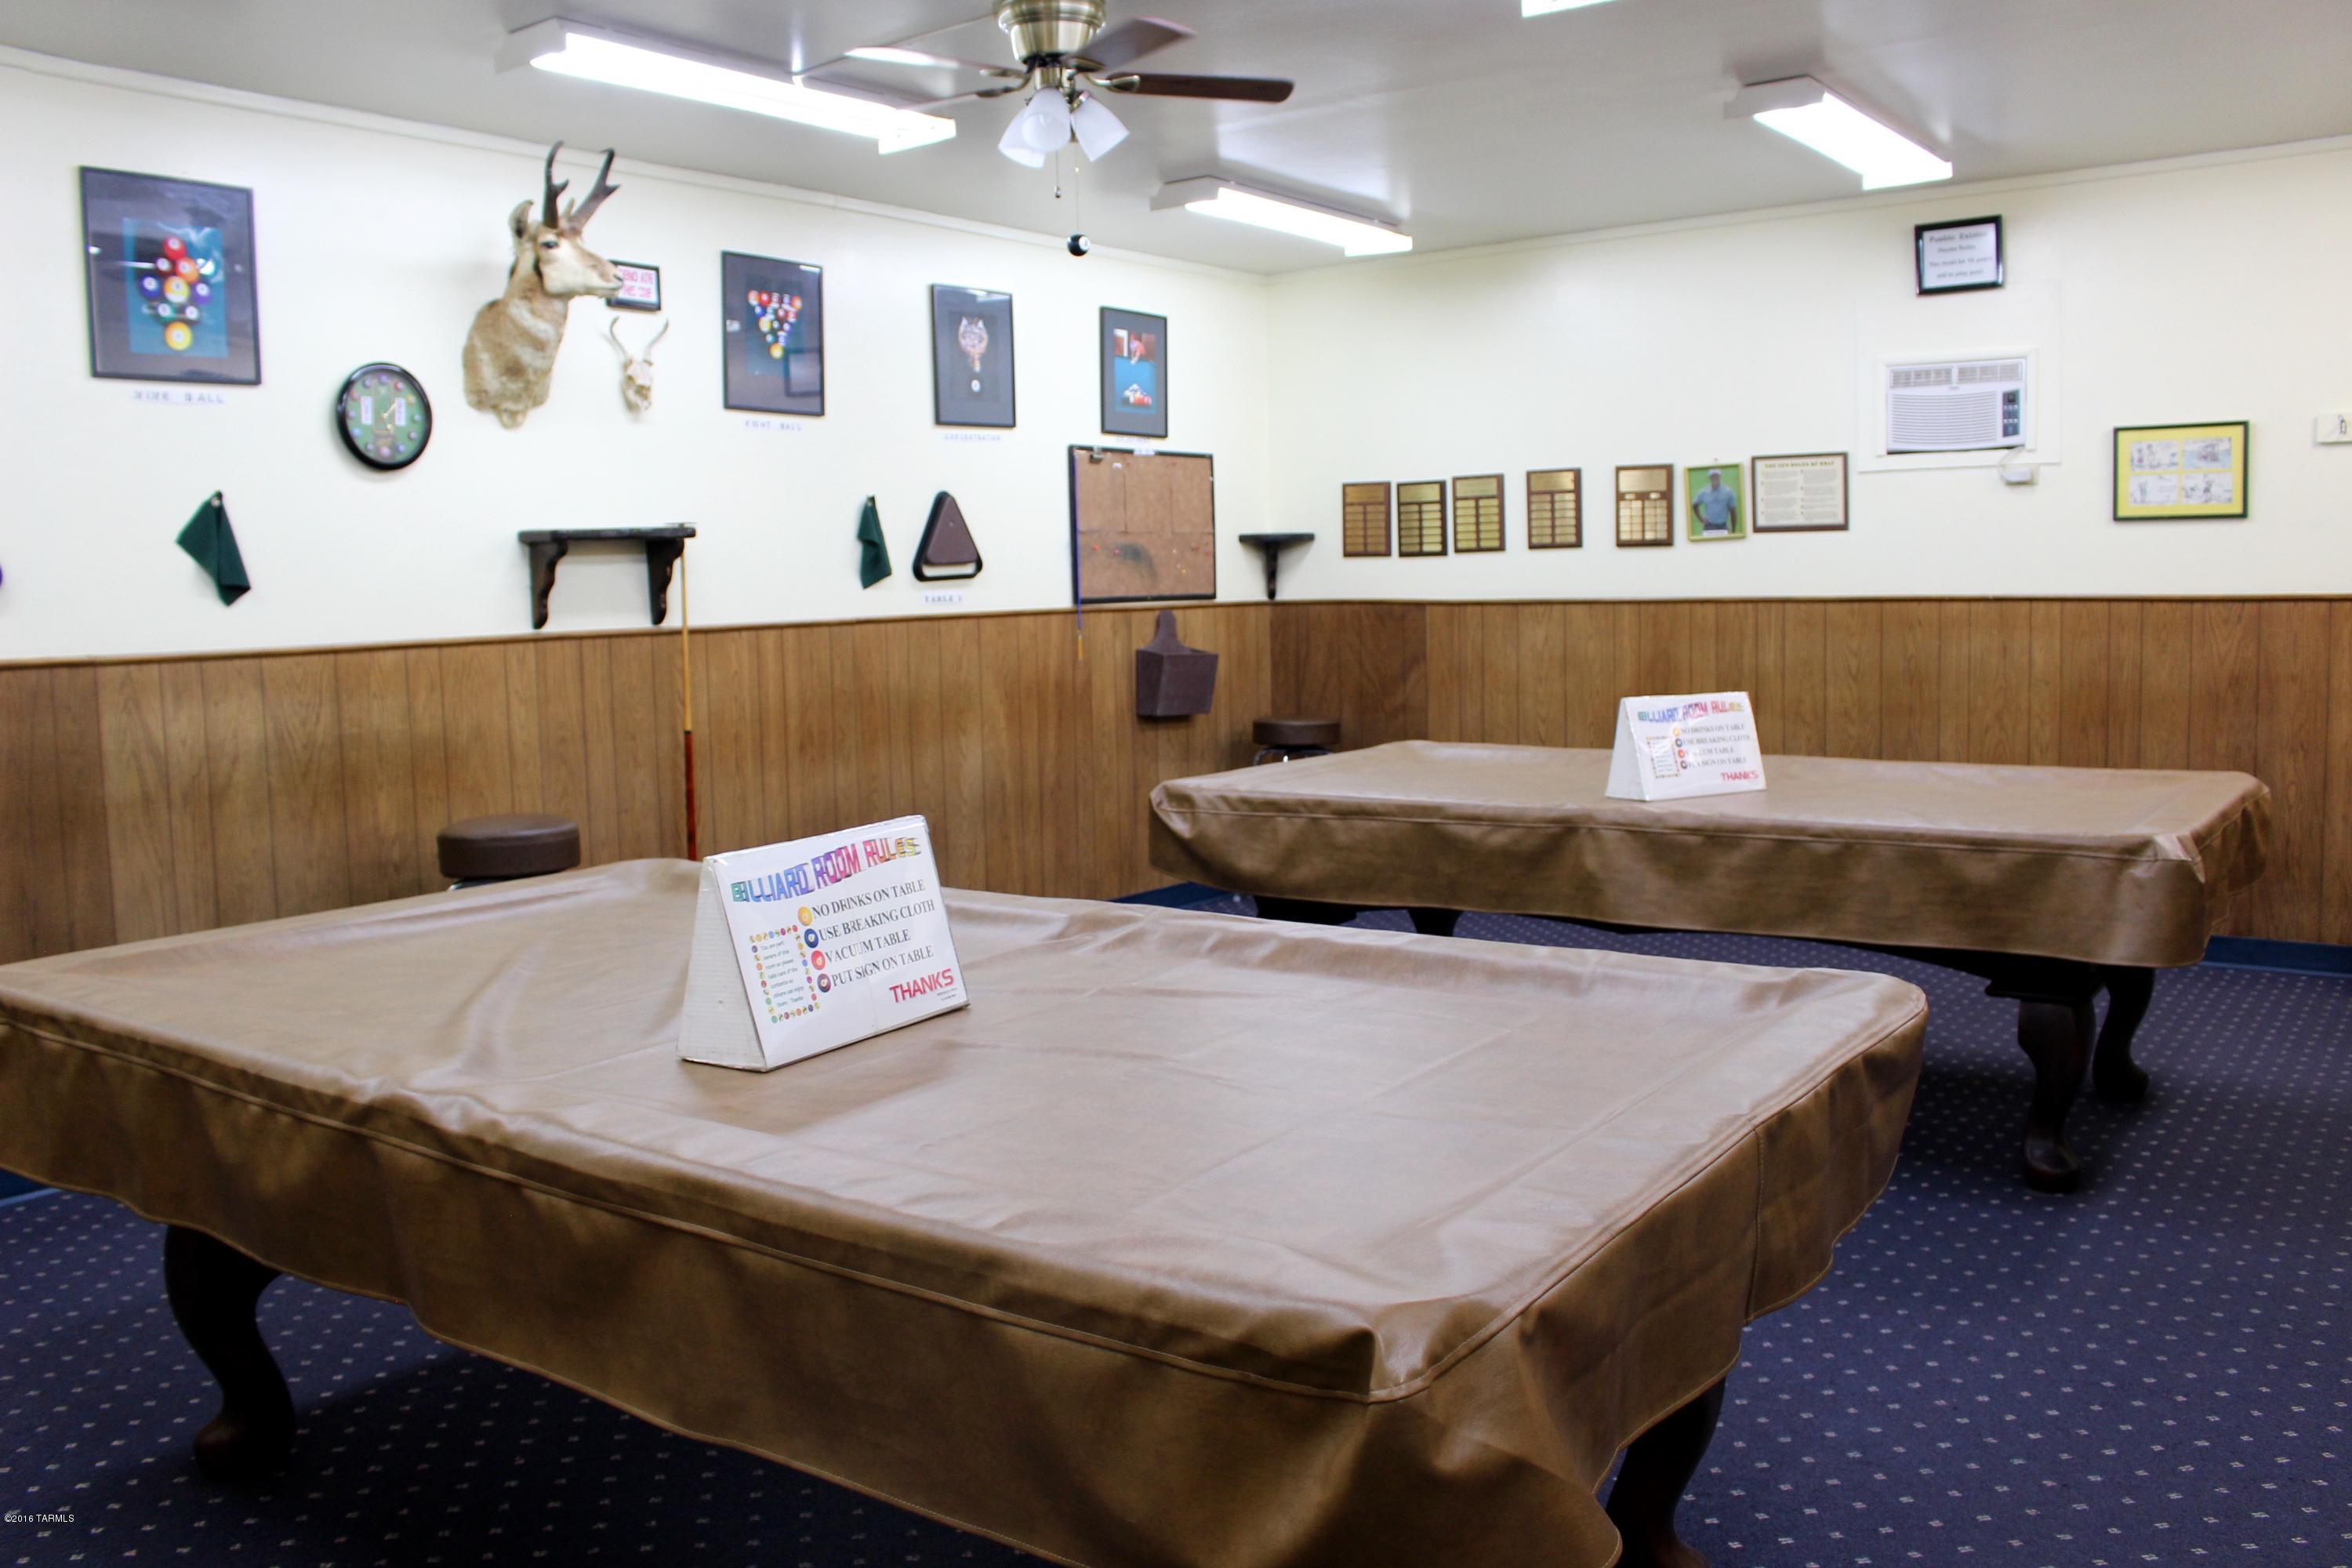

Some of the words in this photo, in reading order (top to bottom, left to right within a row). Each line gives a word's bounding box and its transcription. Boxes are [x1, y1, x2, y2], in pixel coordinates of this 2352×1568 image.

[1720, 770, 1759, 782] THANKS
[730, 862, 815, 902] BILLIARD
[811, 843, 862, 890] ROOM
[862, 837, 922, 868] RULES
[811, 903, 830, 920] NO
[831, 892, 872, 914] DRINKS
[873, 887, 890, 903] ON
[891, 879, 926, 898] TABLE
[818, 924, 841, 942] USE
[842, 909, 898, 935] BREAKING
[899, 898, 935, 919] CLOTH
[825, 939, 874, 964] VACUUM
[874, 928, 911, 949] TABLE
[831, 969, 853, 987] PUT
[854, 960, 881, 980] SIGN
[882, 955, 898, 971] ON
[898, 945, 935, 966] TABLE
[888, 968, 954, 1004] THANKS
